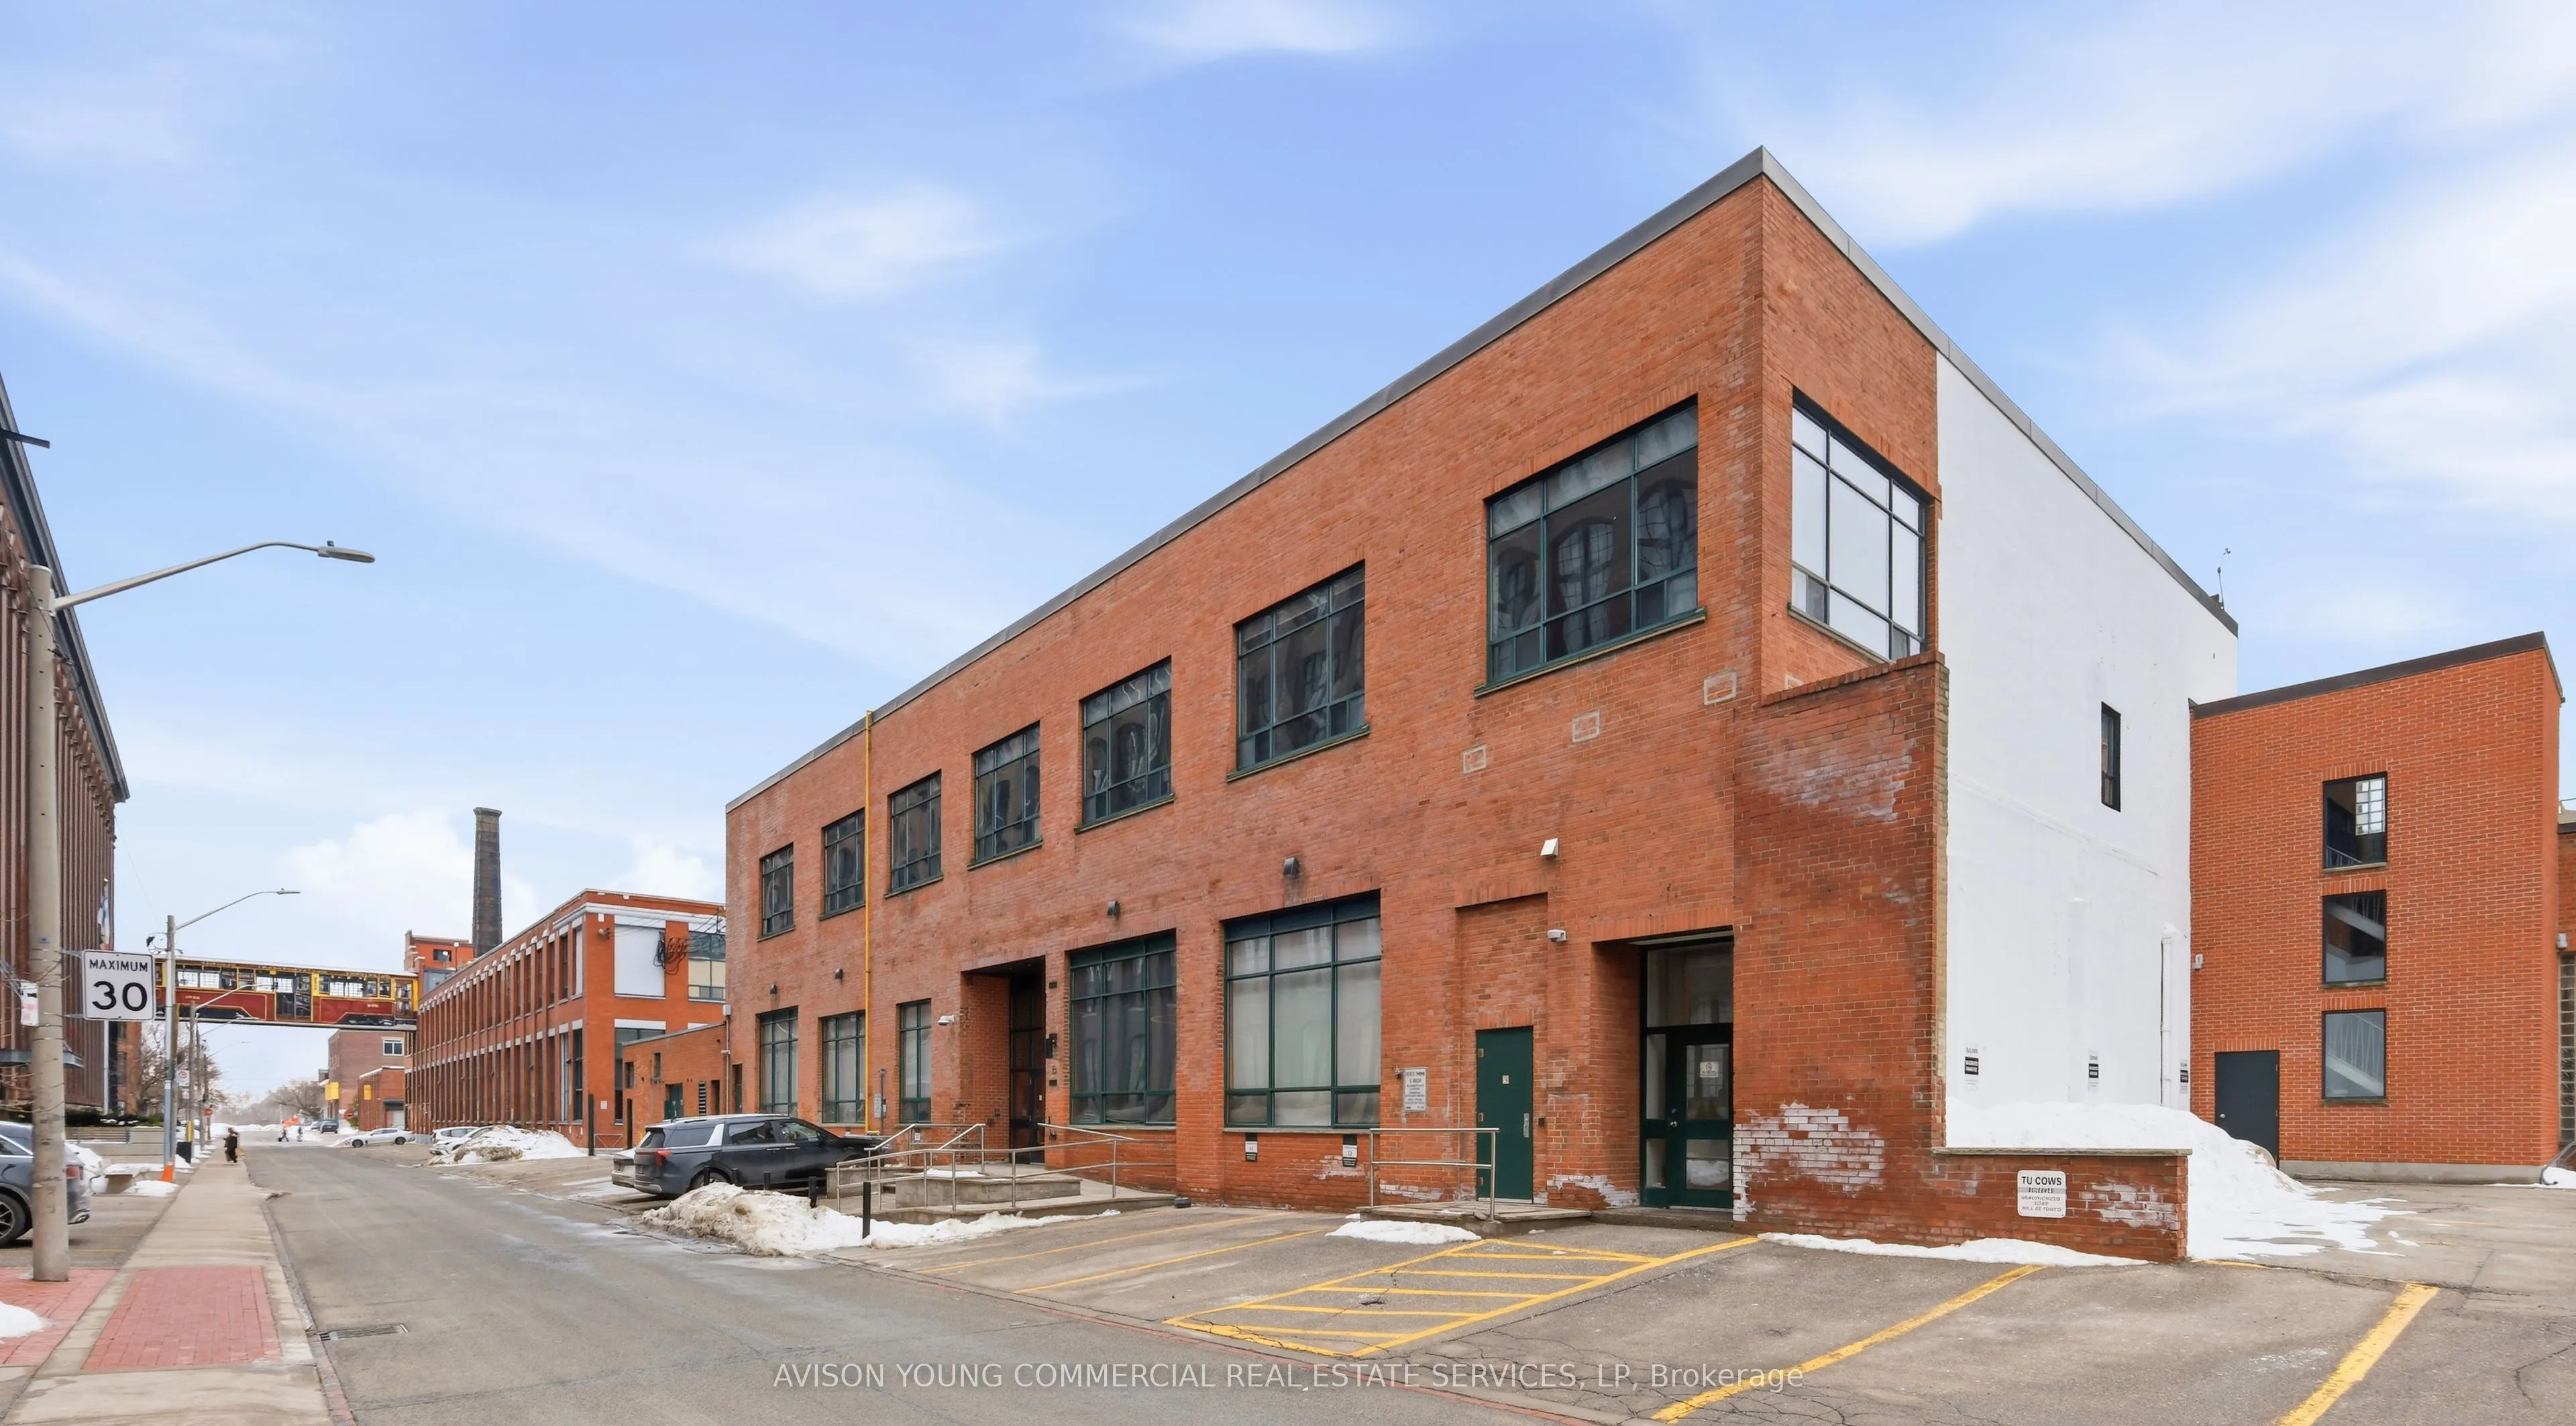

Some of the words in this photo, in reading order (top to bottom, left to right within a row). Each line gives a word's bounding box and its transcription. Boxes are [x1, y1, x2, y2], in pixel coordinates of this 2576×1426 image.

[89, 959, 148, 972] MAXIMUM
[92, 981, 148, 1011] 30
[2021, 1176, 2033, 1185] TU
[2035, 1176, 2062, 1186] COWS
